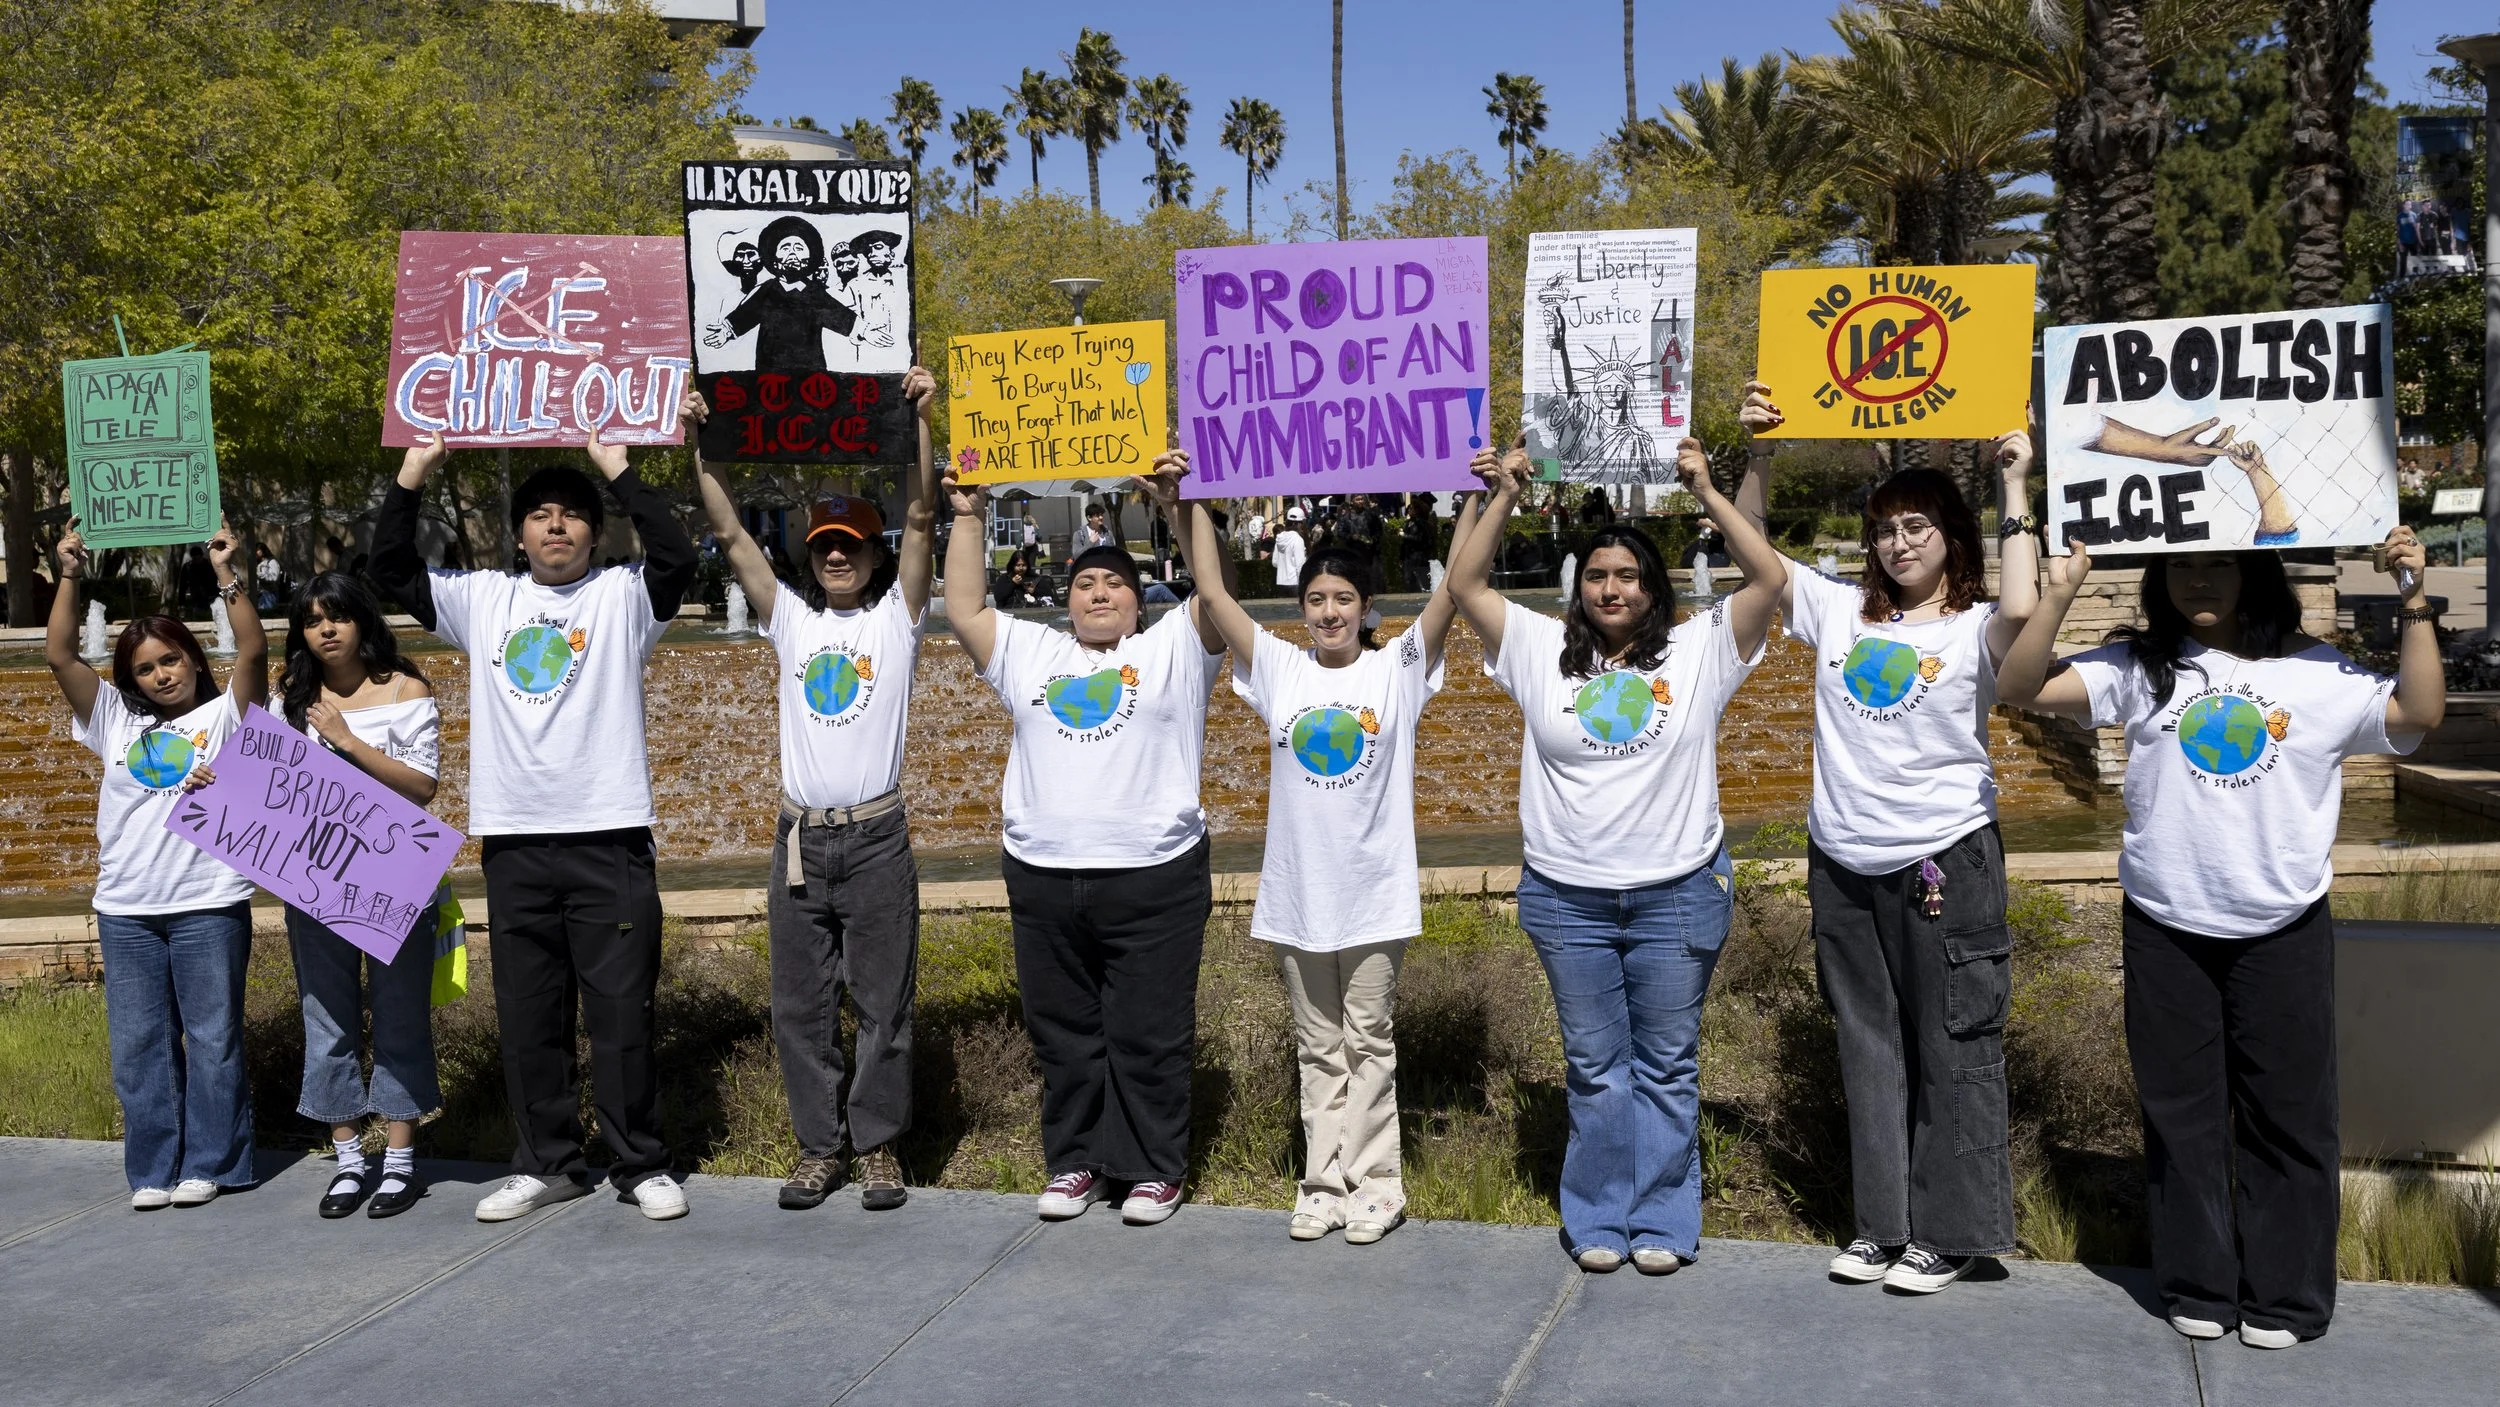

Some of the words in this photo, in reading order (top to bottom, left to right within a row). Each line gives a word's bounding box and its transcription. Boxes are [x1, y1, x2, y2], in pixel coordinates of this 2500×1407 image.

[837, 168, 912, 205] QUE?
[1534, 233, 1564, 241] Haitian
[1566, 232, 1599, 240] families
[1534, 243, 1559, 252] under
[1435, 254, 1475, 271] MIGRA
[1534, 254, 1562, 262] claims
[1563, 253, 1593, 262] sprad
[1576, 246, 1664, 288] Liberty
[1203, 261, 1435, 337] PROUD
[1568, 295, 1642, 328] Justice
[1651, 298, 1681, 334] 4
[1806, 284, 1852, 330] NO
[1869, 271, 1972, 323] HUMAN
[949, 344, 1006, 379] They
[1013, 339, 1065, 365] Keep
[1071, 330, 1134, 367] Trying
[1338, 336, 1389, 385] OF
[1397, 320, 1475, 379] AN
[2063, 318, 2384, 406] ABOLISH
[86, 372, 169, 403] APAGA
[395, 351, 560, 434] CHILL
[572, 354, 690, 434] OUT
[714, 372, 880, 413] STOP
[991, 376, 1018, 401] To
[1024, 373, 1067, 403] Bury
[1070, 368, 1103, 393] Us,
[1659, 336, 1685, 428] ALL
[132, 394, 159, 416] LA
[964, 410, 1011, 444] They
[1016, 403, 1064, 441] Forget
[1068, 399, 1105, 427] That
[1110, 396, 1139, 422] We
[1813, 381, 1843, 410] IS
[1851, 382, 1957, 429] ILLEGAL
[83, 417, 159, 441] TELE
[1192, 387, 1485, 483] IMMIGRANT!
[984, 443, 1022, 470] ARE
[1026, 437, 1064, 470] THE
[1066, 433, 1140, 467] SEEDS
[92, 493, 177, 527] MIENTE
[538, 611, 568, 630] illegal
[509, 689, 522, 700] on
[527, 689, 562, 705] stolen
[809, 712, 821, 724] on
[825, 713, 860, 728] stolen
[855, 685, 873, 711] land
[1031, 692, 1046, 706] No
[1843, 696, 1856, 711] on
[1859, 707, 1903, 722] stolen
[1901, 683, 1929, 712] land
[2169, 686, 2220, 717] human
[2224, 683, 2233, 693] is
[2237, 682, 2276, 709] illegal
[1057, 727, 1073, 741] on
[1080, 722, 1124, 743] stolen
[1117, 688, 1138, 720] land
[1581, 737, 1598, 751] on
[1604, 741, 1650, 756] stolen
[1644, 709, 1668, 740] land
[2161, 718, 2178, 732] No
[240, 727, 308, 768] BUILD
[1305, 776, 1319, 788] on
[1325, 772, 1365, 790] stolen
[1358, 739, 1376, 769] land
[143, 788, 158, 796] on
[162, 783, 187, 797] stole
[2190, 769, 2207, 783] on
[2214, 774, 2261, 789] stolen
[264, 767, 406, 855] BRIDGES
[214, 804, 320, 904] WALLS
[294, 814, 371, 883] NOT
